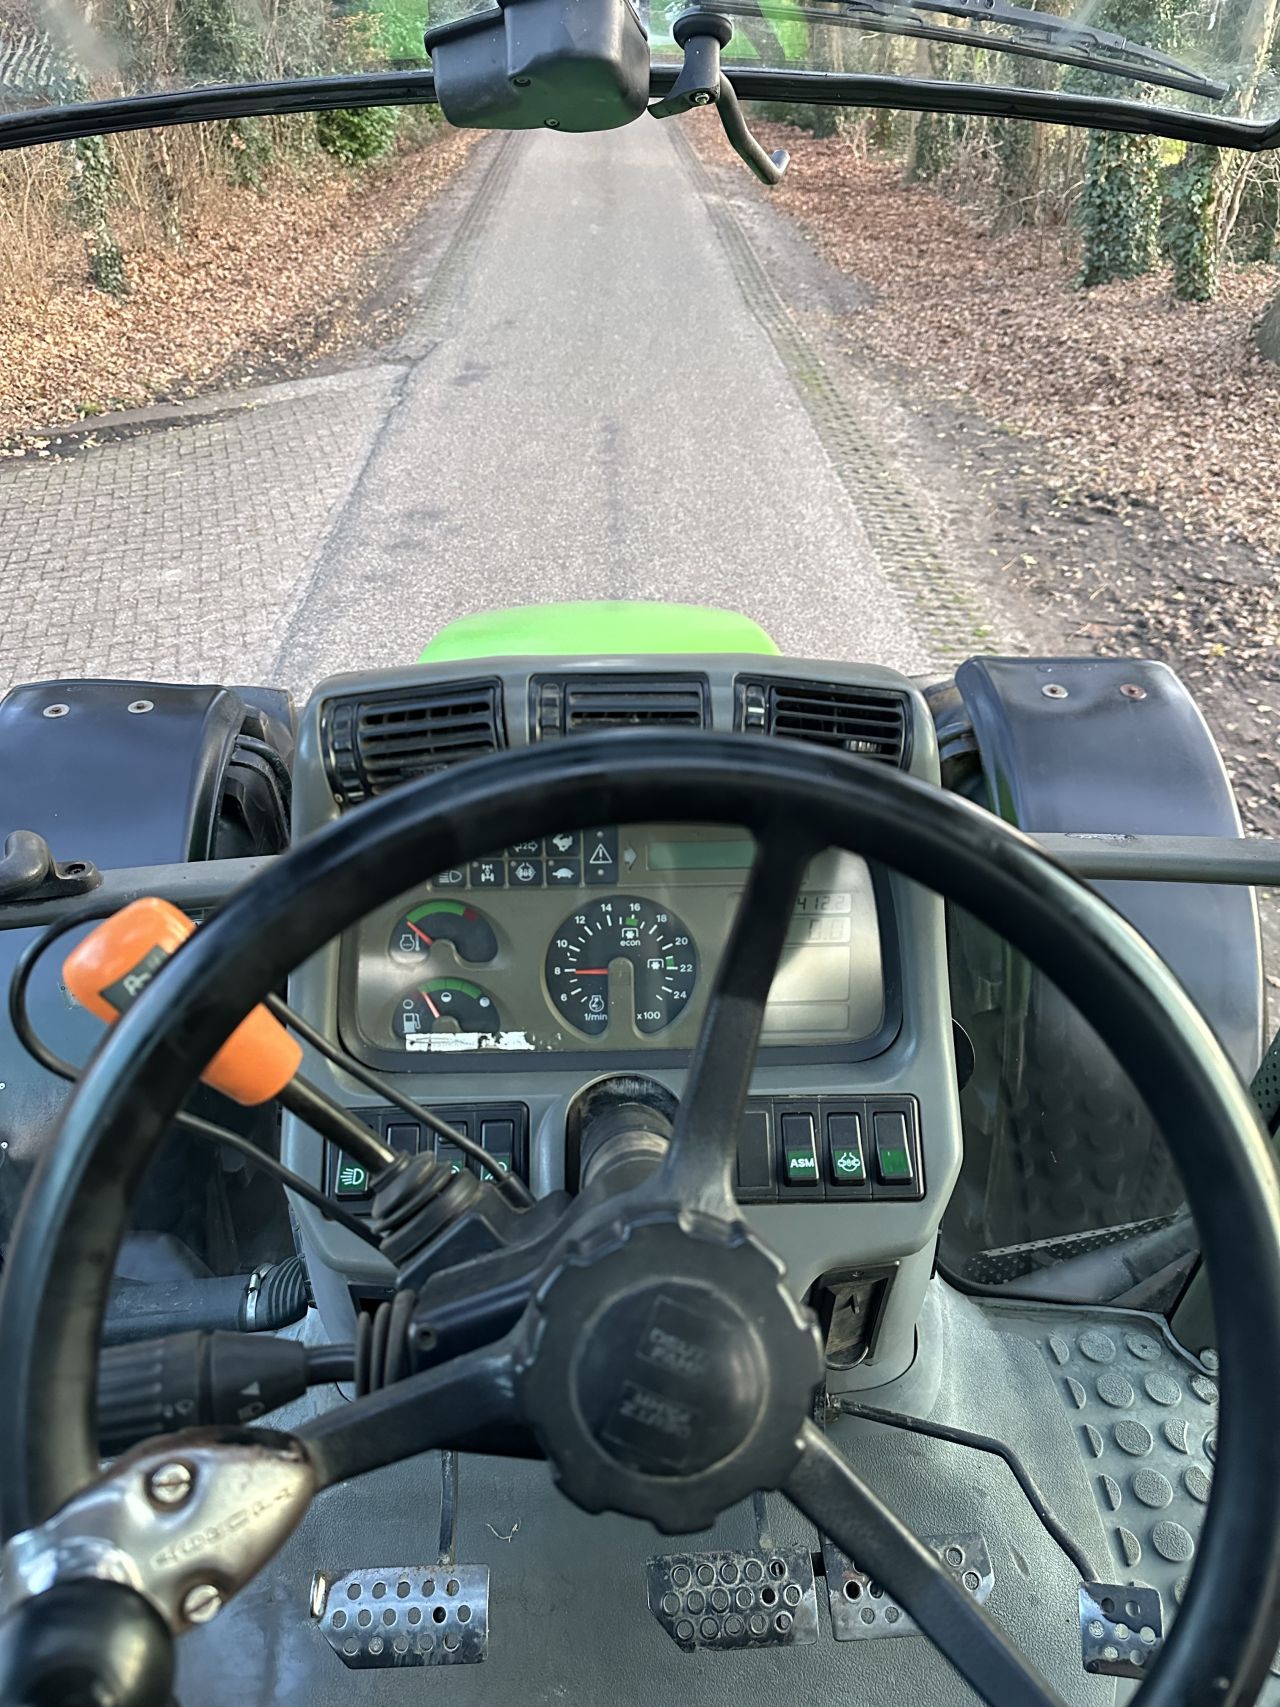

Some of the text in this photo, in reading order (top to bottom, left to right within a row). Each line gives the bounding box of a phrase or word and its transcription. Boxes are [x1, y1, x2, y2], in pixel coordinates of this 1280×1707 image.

[600, 903, 613, 912] 14
[629, 902, 641, 912] 16
[574, 915, 587, 925] 12
[655, 914, 668, 923] 18
[556, 939, 570, 949] 10
[619, 938, 642, 947] econ
[674, 936, 689, 946] 20
[554, 966, 562, 976] 8
[679, 963, 693, 973] 22
[560, 993, 568, 1003] 6
[672, 989, 688, 1000] 24
[584, 1012, 608, 1021] 1/min
[790, 1158, 815, 1169] ASM
